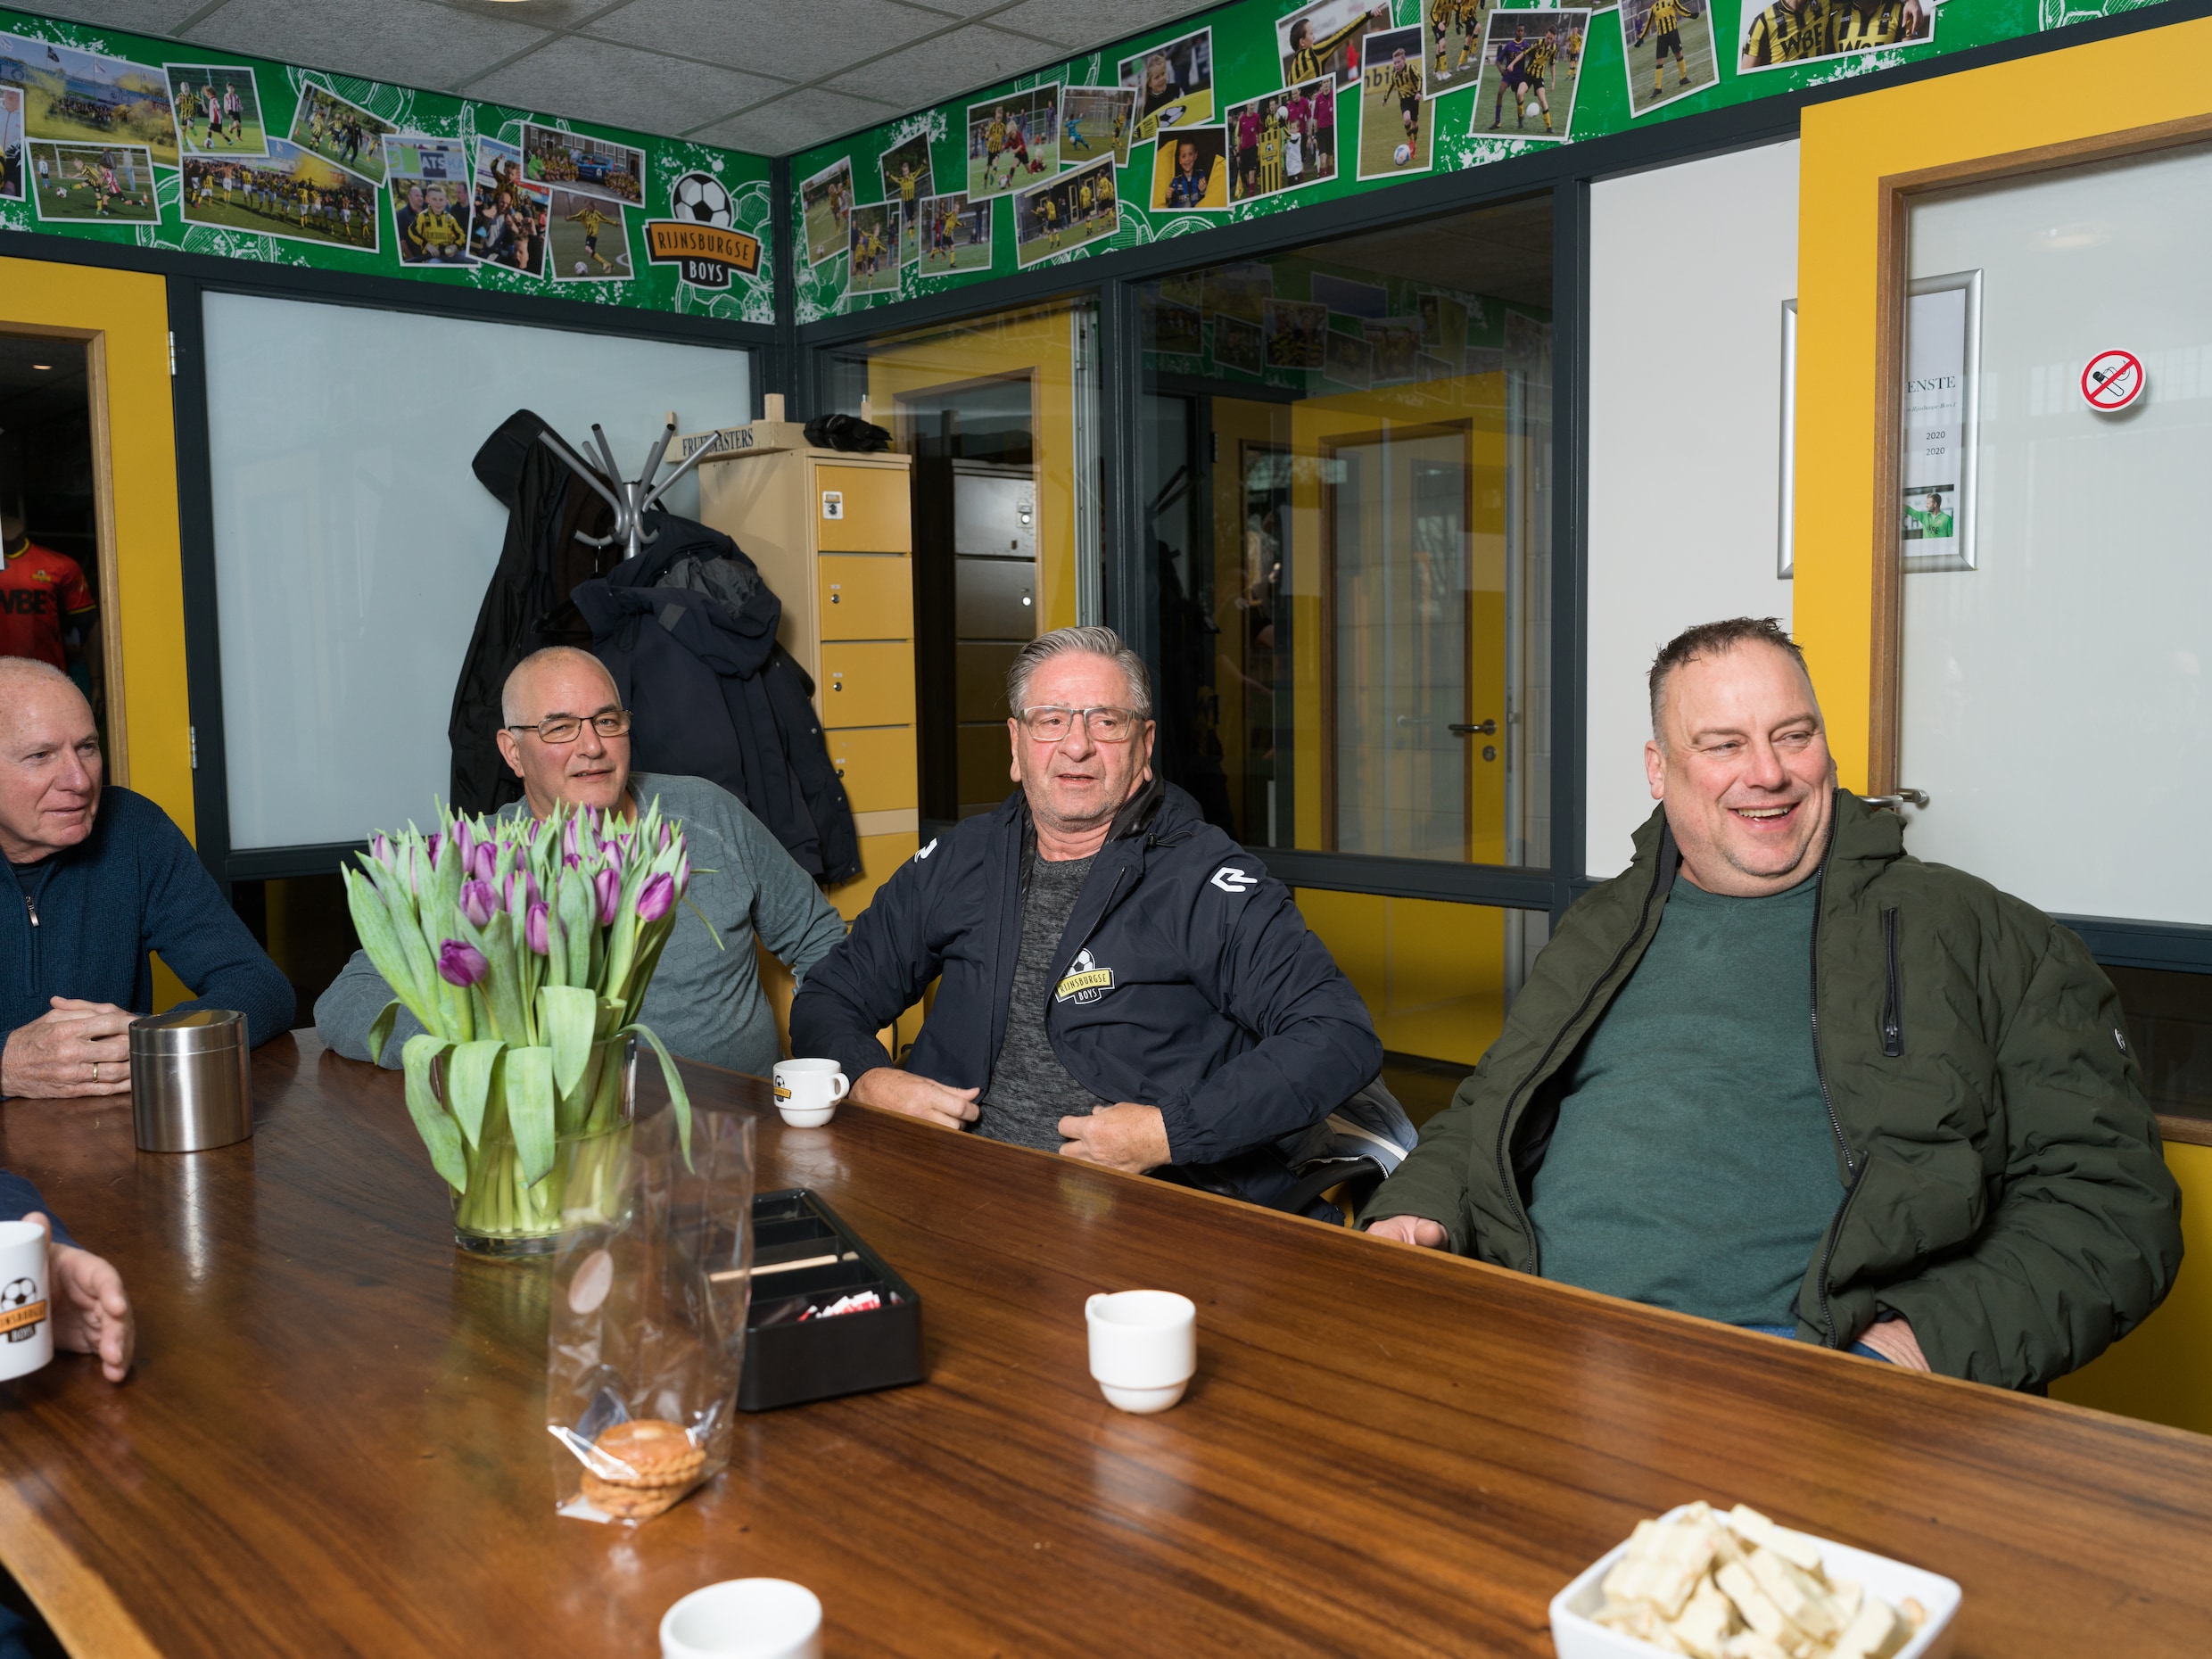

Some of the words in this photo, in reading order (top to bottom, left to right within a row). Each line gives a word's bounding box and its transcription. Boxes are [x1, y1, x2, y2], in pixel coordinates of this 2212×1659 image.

[1780, 22, 1822, 57] WBE
[422, 155, 445, 169] ATS
[657, 231, 749, 261] RIJNSBURGSE
[689, 260, 723, 283] BOYS
[682, 428, 754, 457] FRUIASTERS
[1927, 431, 1946, 440] 2020
[1927, 447, 1945, 456] 2020
[1059, 973, 1107, 994] RIJNSBURGSE
[1077, 988, 1097, 1001] BOYS
